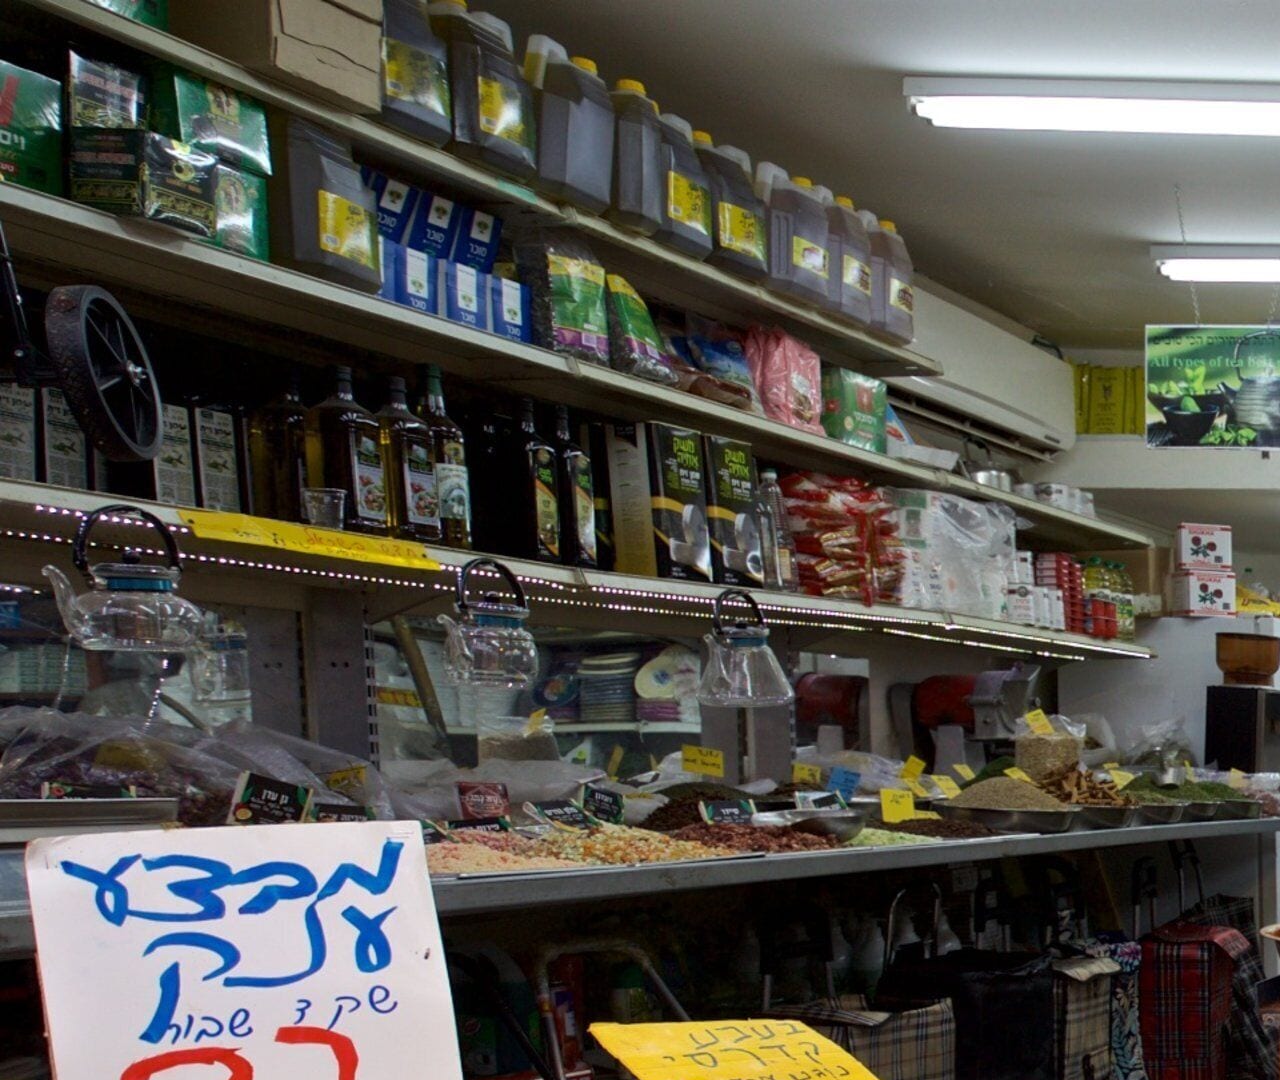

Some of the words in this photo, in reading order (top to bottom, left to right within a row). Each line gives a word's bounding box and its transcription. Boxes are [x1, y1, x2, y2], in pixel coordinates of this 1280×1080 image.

[1151, 357, 1169, 367] All
[1173, 356, 1206, 370] types
[1209, 357, 1221, 367] of
[61, 837, 405, 926] מבצע
[139, 900, 398, 1044] ענק
